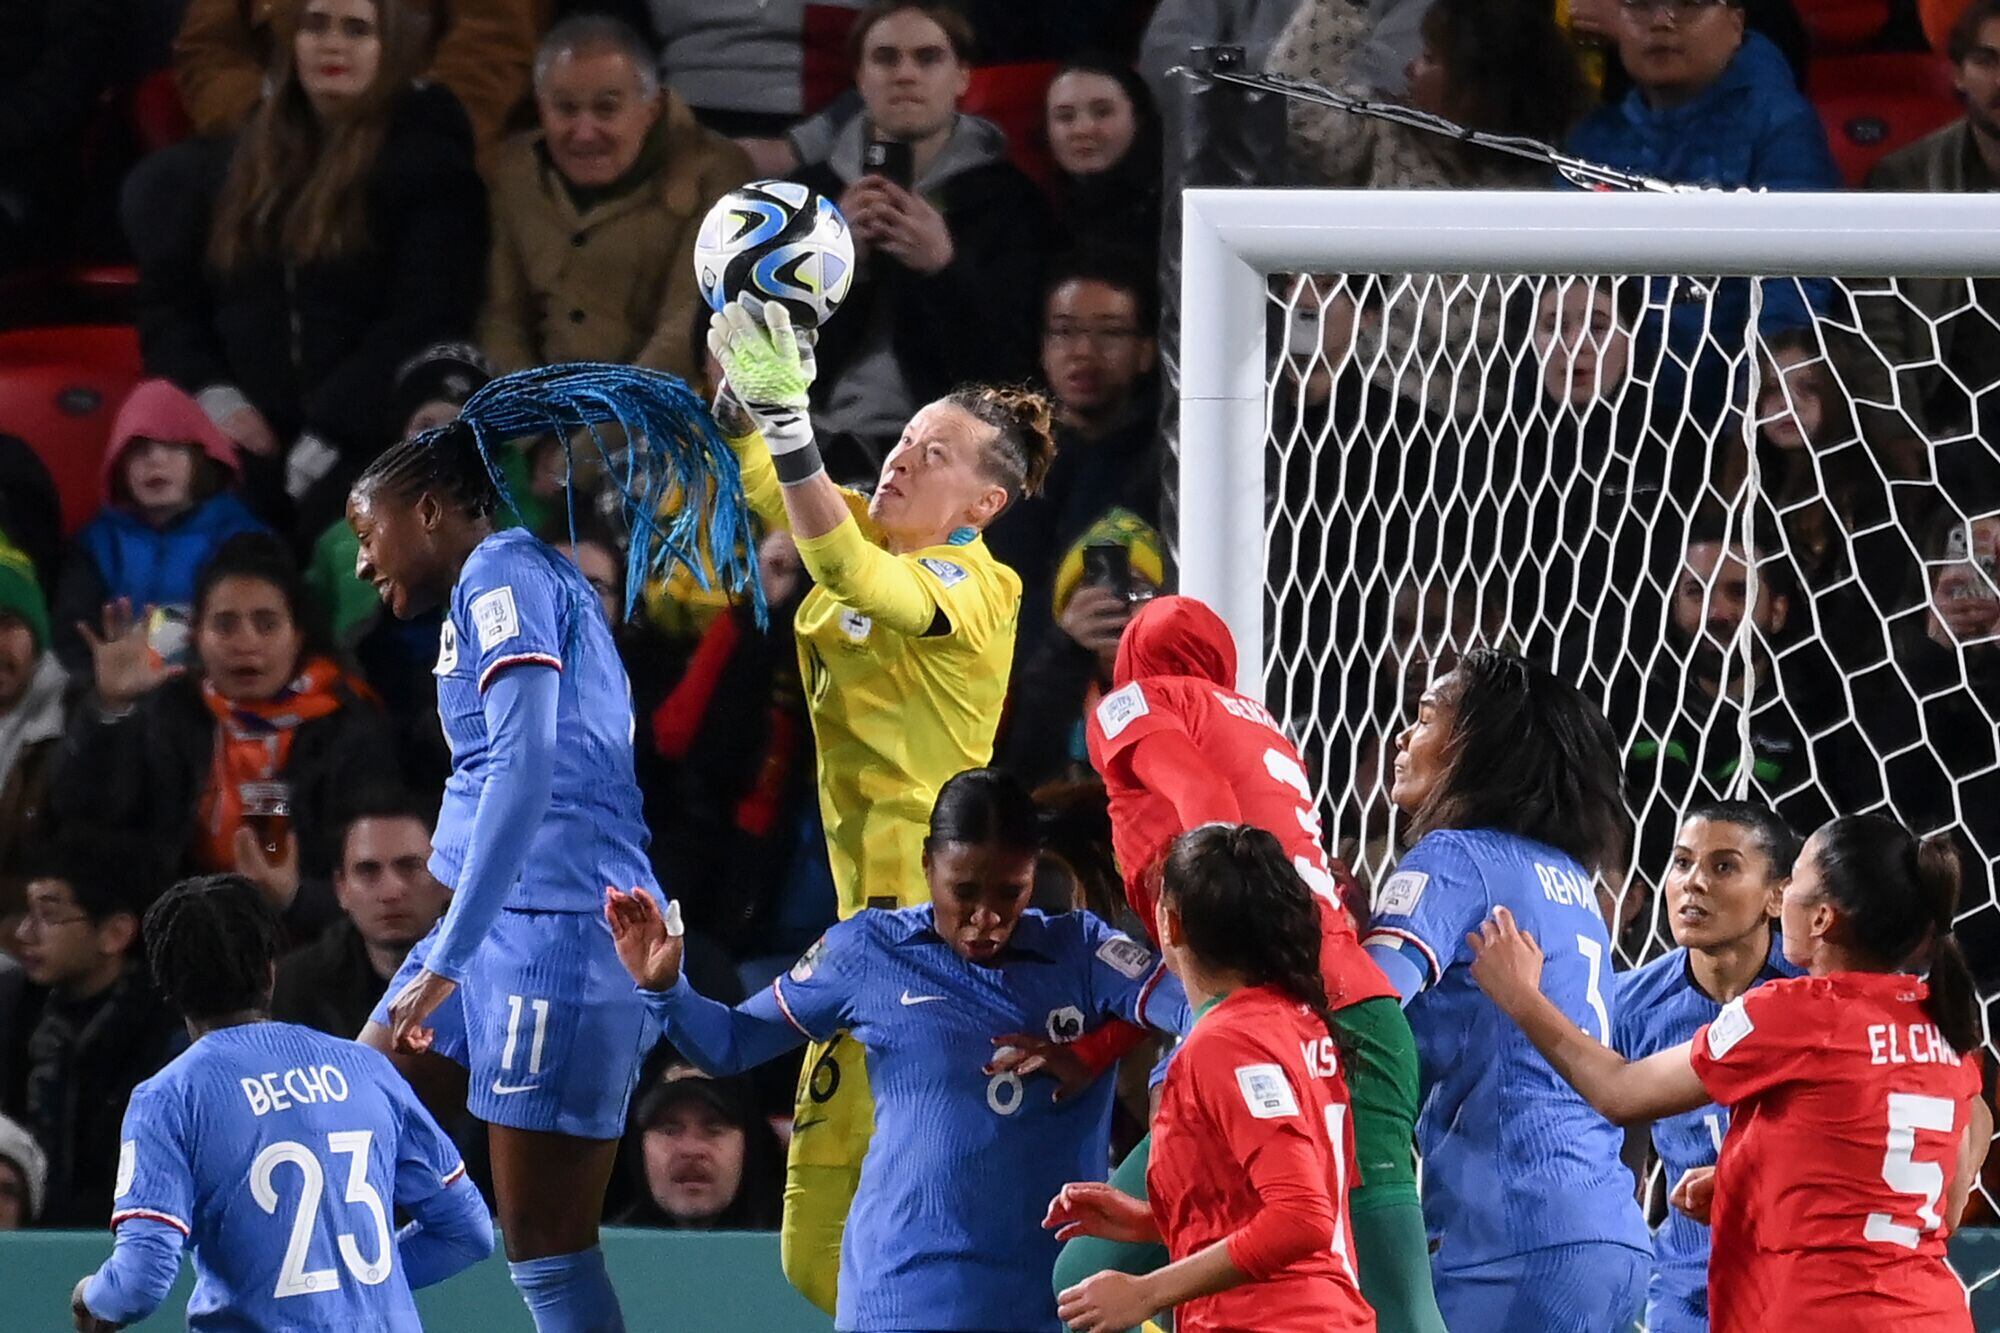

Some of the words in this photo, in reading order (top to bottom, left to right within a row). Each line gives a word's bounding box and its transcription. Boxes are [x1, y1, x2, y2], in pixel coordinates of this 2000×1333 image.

[501, 994, 549, 1074] 11
[1867, 1023, 1906, 1065] EL
[1909, 1023, 1962, 1068] CHA
[240, 1064, 349, 1117] BECHO
[1862, 1091, 1955, 1249] 5
[249, 1130, 392, 1299] 23
